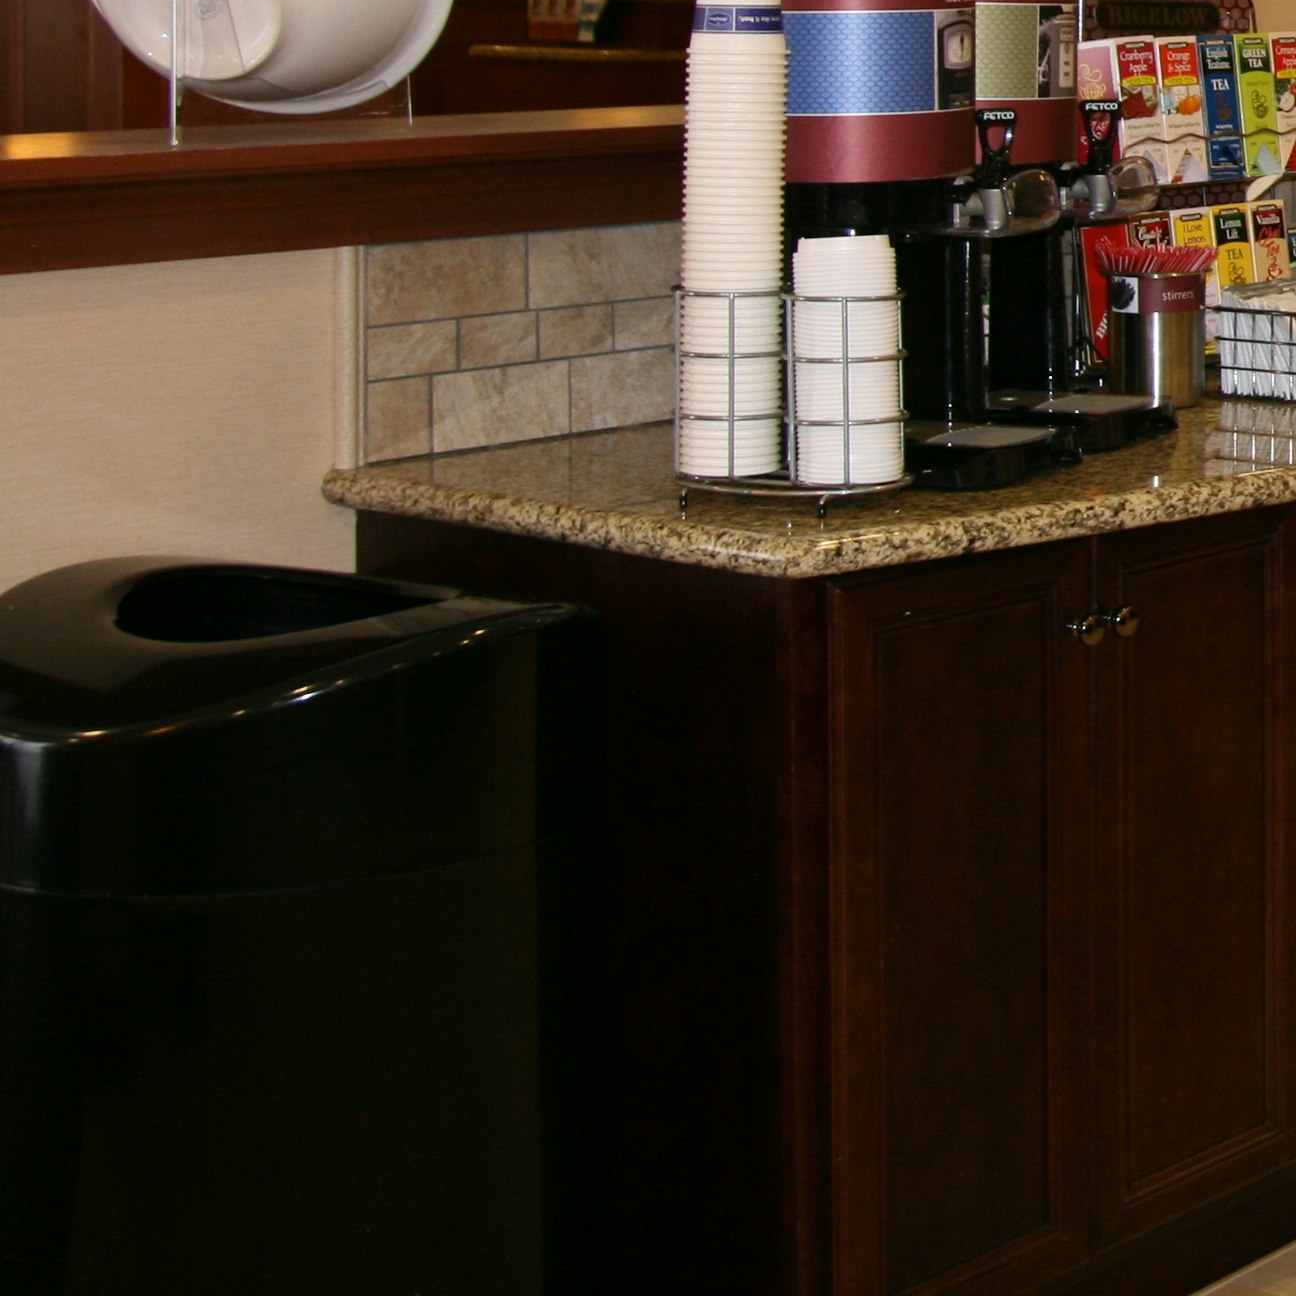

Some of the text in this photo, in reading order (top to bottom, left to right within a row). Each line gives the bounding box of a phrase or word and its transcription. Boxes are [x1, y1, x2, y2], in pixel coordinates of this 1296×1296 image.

[1242, 49, 1266, 58] GREEN
[1248, 58, 1263, 68] TEA
[1211, 79, 1230, 91] TEA
[1085, 102, 1118, 110] FETCO
[983, 111, 1015, 120] FETCO
[1225, 248, 1244, 260] TEA
[1162, 290, 1194, 301] stirrers
